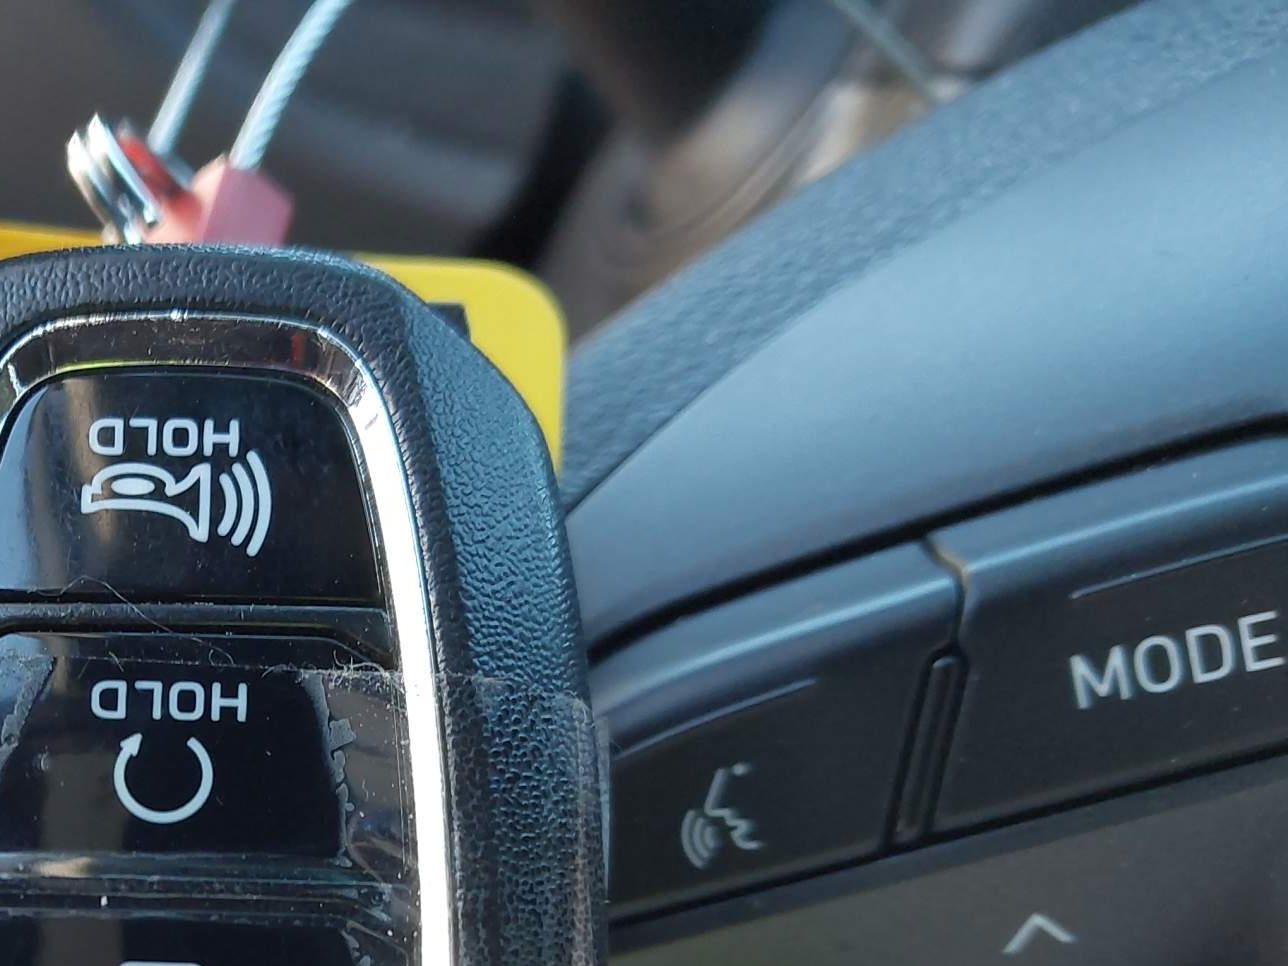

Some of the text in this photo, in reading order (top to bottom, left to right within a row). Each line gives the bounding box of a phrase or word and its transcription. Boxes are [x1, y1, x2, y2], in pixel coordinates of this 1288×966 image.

[88, 417, 241, 458] HOLD
[1068, 609, 1287, 710] MODE
[90, 679, 249, 723] HOLD
